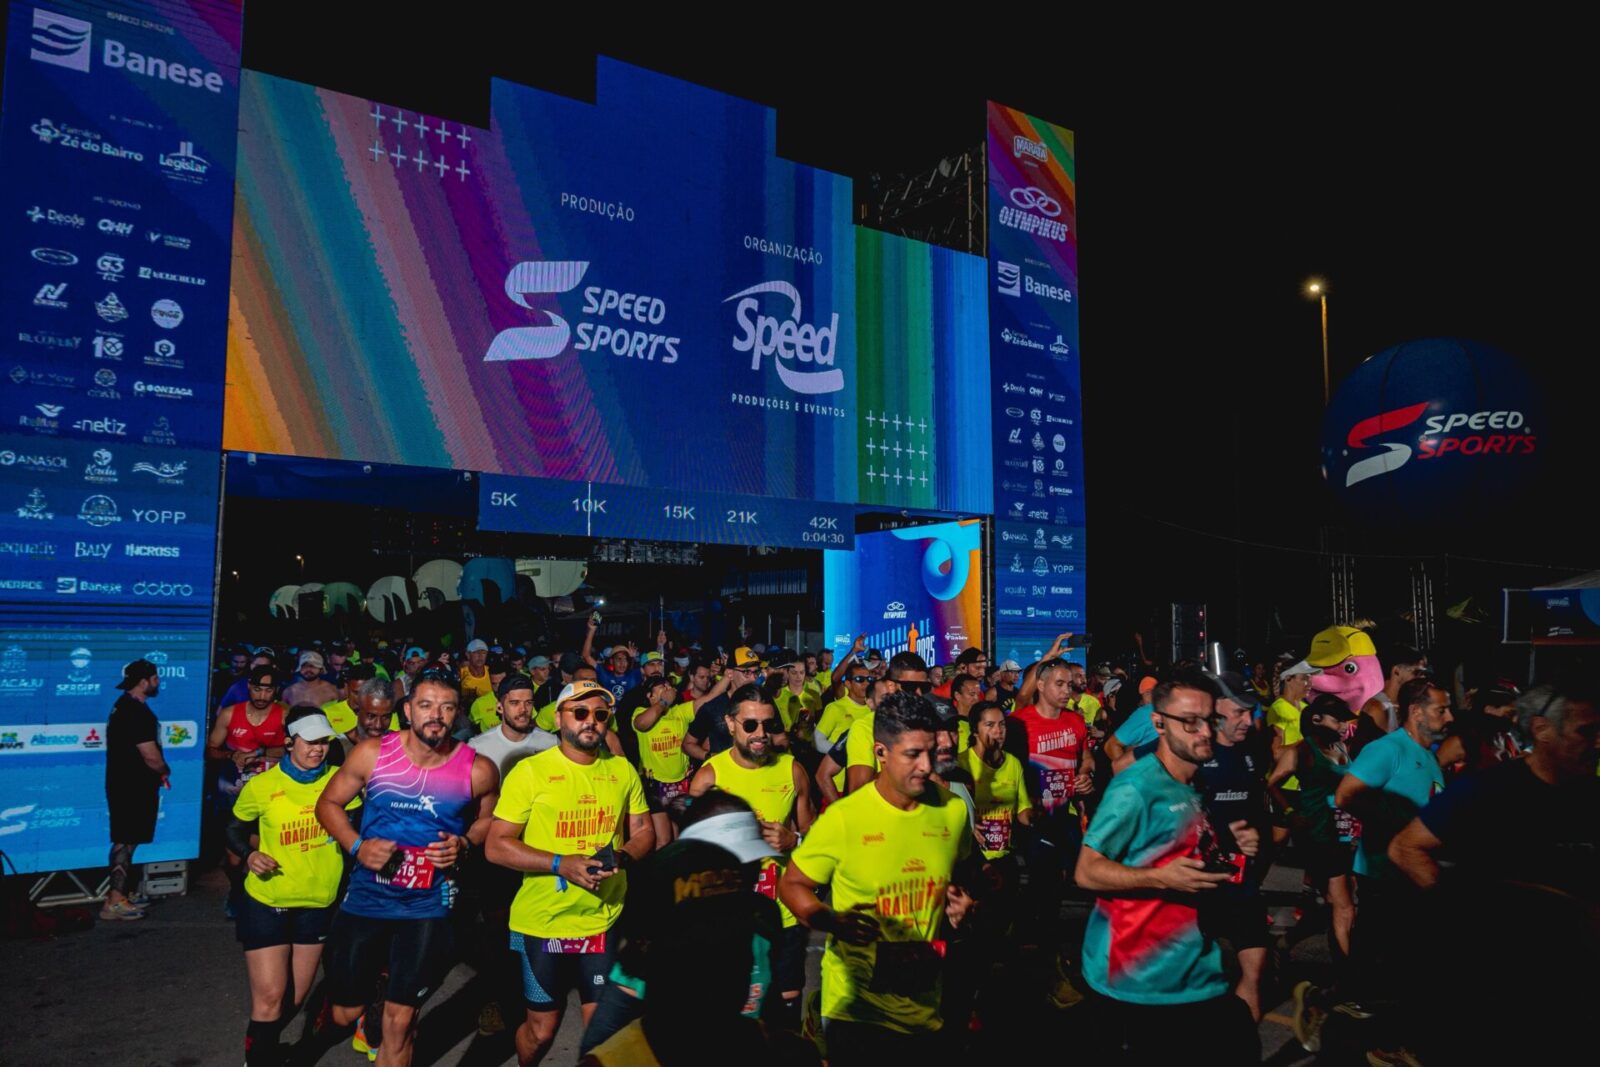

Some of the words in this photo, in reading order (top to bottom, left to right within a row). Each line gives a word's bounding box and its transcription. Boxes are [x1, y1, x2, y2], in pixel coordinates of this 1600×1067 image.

[103, 39, 224, 93] Banese
[60, 135, 80, 149] Zé
[81, 139, 100, 152] do
[102, 142, 144, 162] Bairro
[159, 153, 208, 174] Legislar
[561, 192, 635, 222] PRODUÇÃO
[999, 205, 1068, 243] OLYMPIKUS
[744, 235, 823, 265] ORGANIZAÇÃO
[1024, 275, 1071, 303] Banese
[582, 286, 666, 325] SPEED
[574, 322, 680, 364] SPORTS
[732, 297, 839, 371] Speed
[731, 393, 790, 411] PRODUÇÕES
[795, 403, 800, 412] E
[804, 403, 846, 418] EVENTOS
[81, 416, 127, 435] netiz
[1424, 411, 1524, 436] SPEED
[1417, 435, 1537, 460] SPORTS
[17, 454, 69, 469] ANASOL
[490, 491, 518, 508] 5K
[572, 498, 607, 514] 10K
[132, 508, 187, 524] YOPP
[663, 504, 695, 520] 15K
[727, 510, 758, 525] 21K
[809, 516, 838, 530] 42K
[802, 532, 845, 544] 0:04:30
[75, 541, 112, 559] BALY
[1052, 565, 1074, 574] YOPP
[80, 580, 122, 593] Banese
[133, 581, 193, 597] dobro
[0, 678, 44, 688] ACAJU
[1214, 789, 1248, 801] minas
